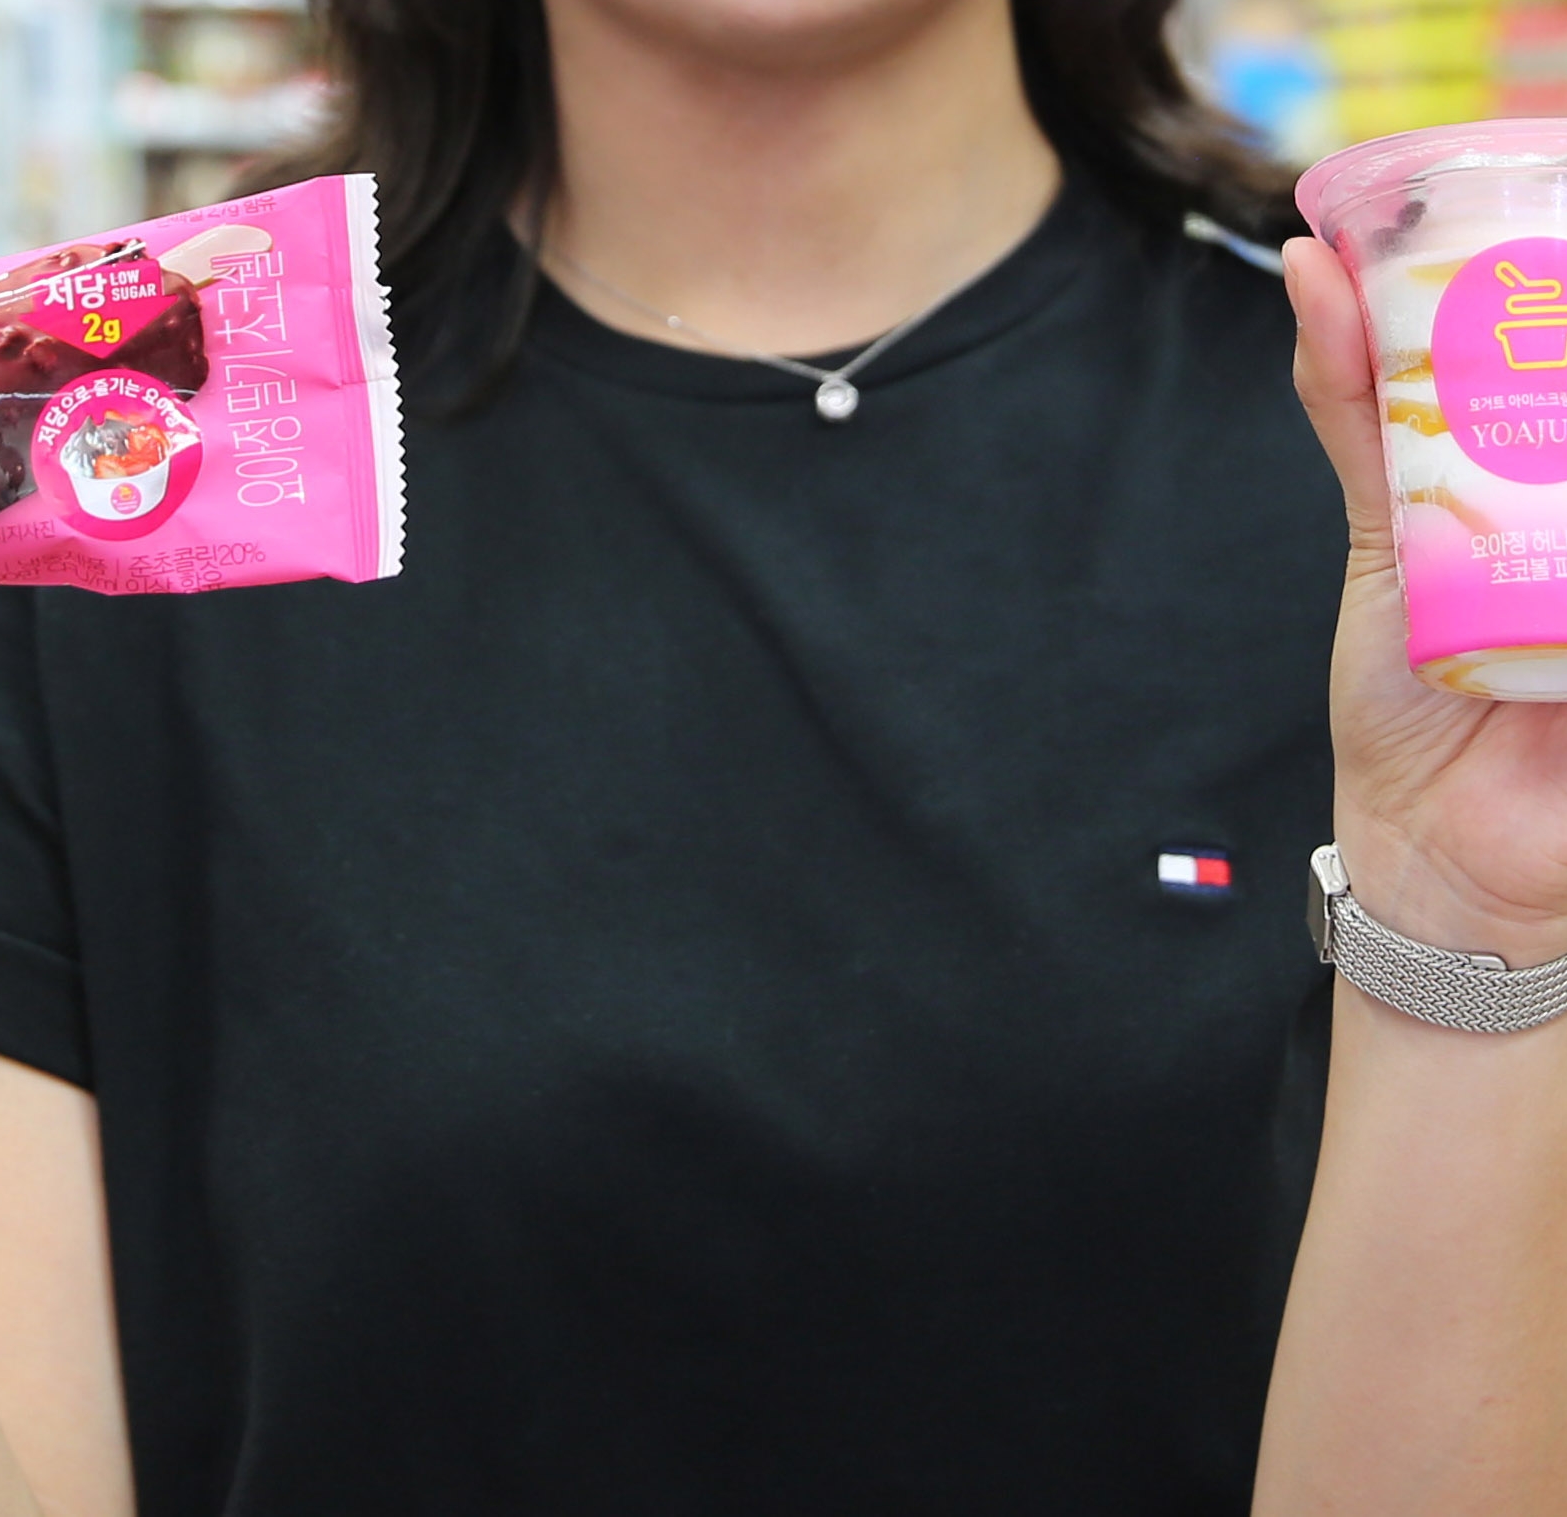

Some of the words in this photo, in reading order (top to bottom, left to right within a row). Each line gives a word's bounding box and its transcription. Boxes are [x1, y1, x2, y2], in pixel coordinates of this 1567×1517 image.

[43, 271, 107, 311] 저당
[110, 269, 140, 286] LOW
[111, 283, 157, 301] SUGAR
[209, 251, 286, 344] 초코쉘
[82, 312, 122, 344] 2g
[220, 349, 297, 414] 딸기
[38, 385, 92, 447] 저당으로
[92, 377, 142, 399] 즐기는
[1469, 395, 1506, 412] 요거트
[228, 416, 306, 507] 요아정
[1470, 531, 1527, 559] 요아정
[1490, 557, 1551, 585] 초코볼
